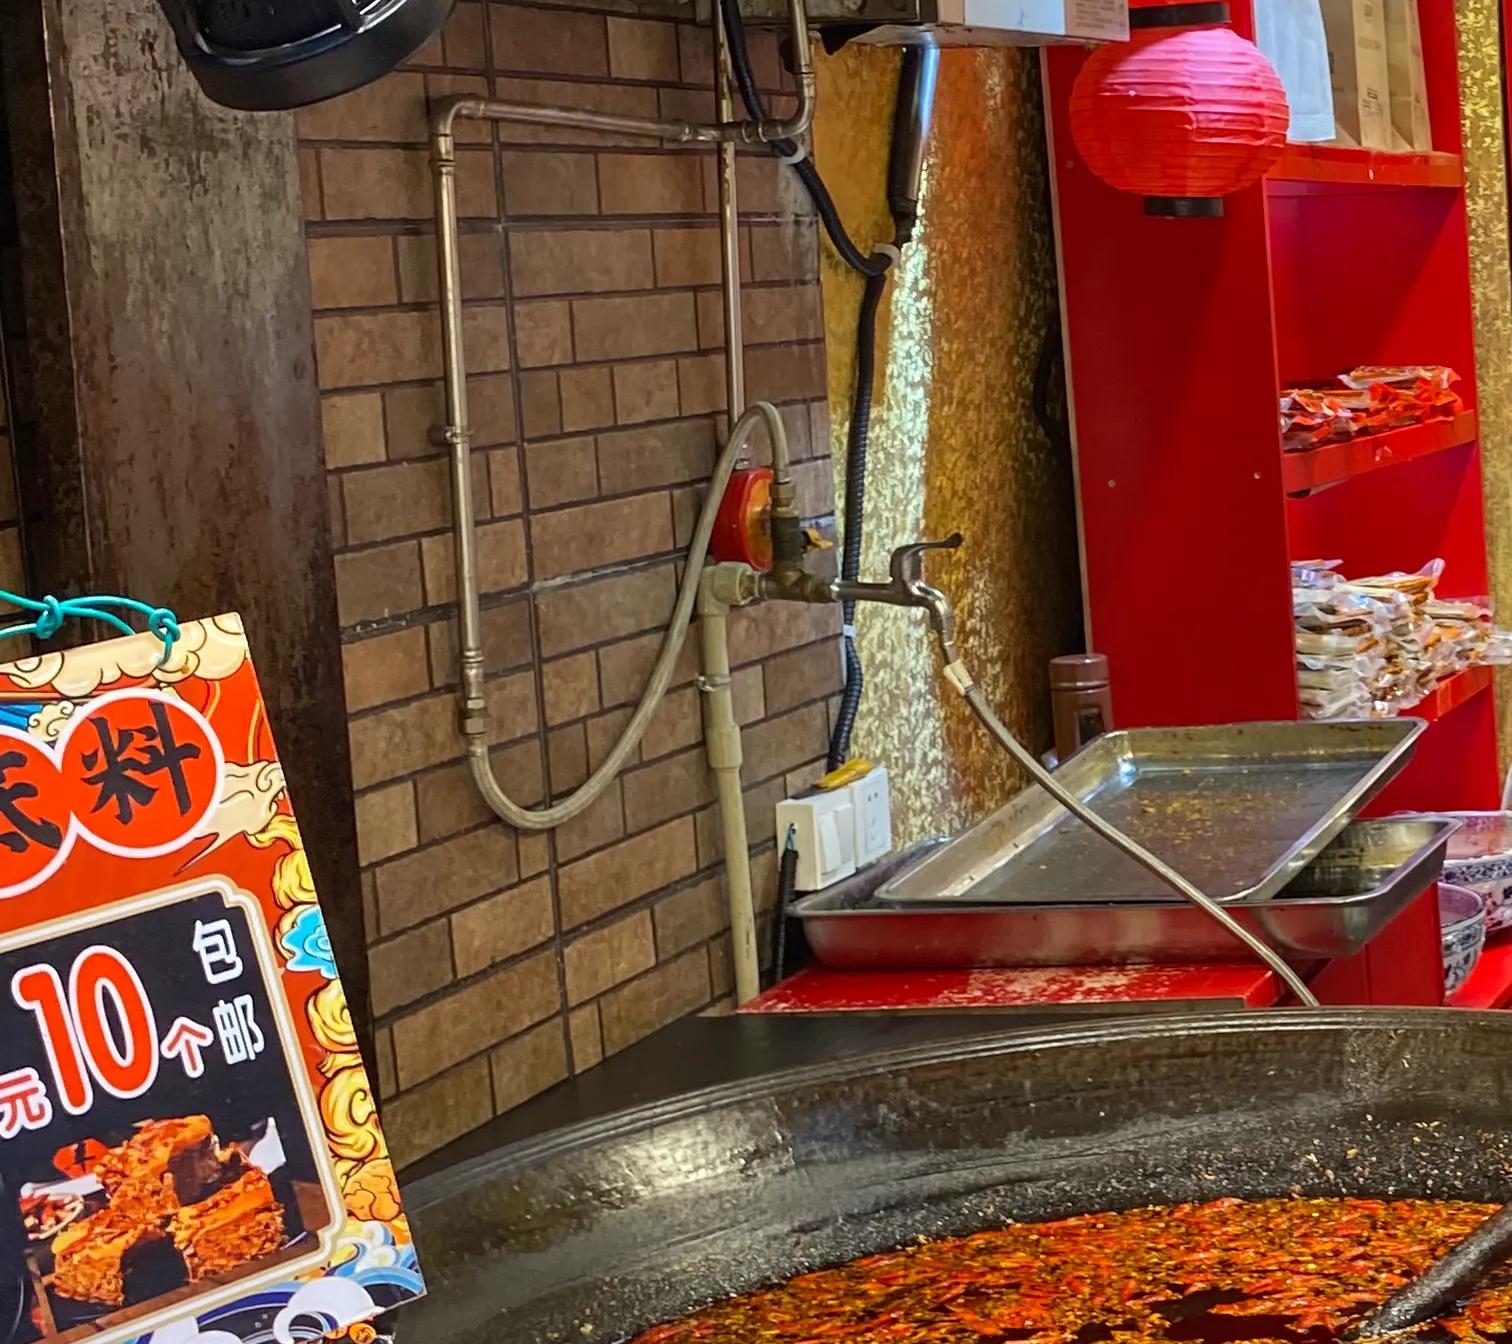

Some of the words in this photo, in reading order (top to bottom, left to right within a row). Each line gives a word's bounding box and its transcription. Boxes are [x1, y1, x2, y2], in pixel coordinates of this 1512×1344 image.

[12, 945, 159, 1115] 10
[161, 1017, 214, 1078] 个
[193, 918, 265, 1066] 包邮
